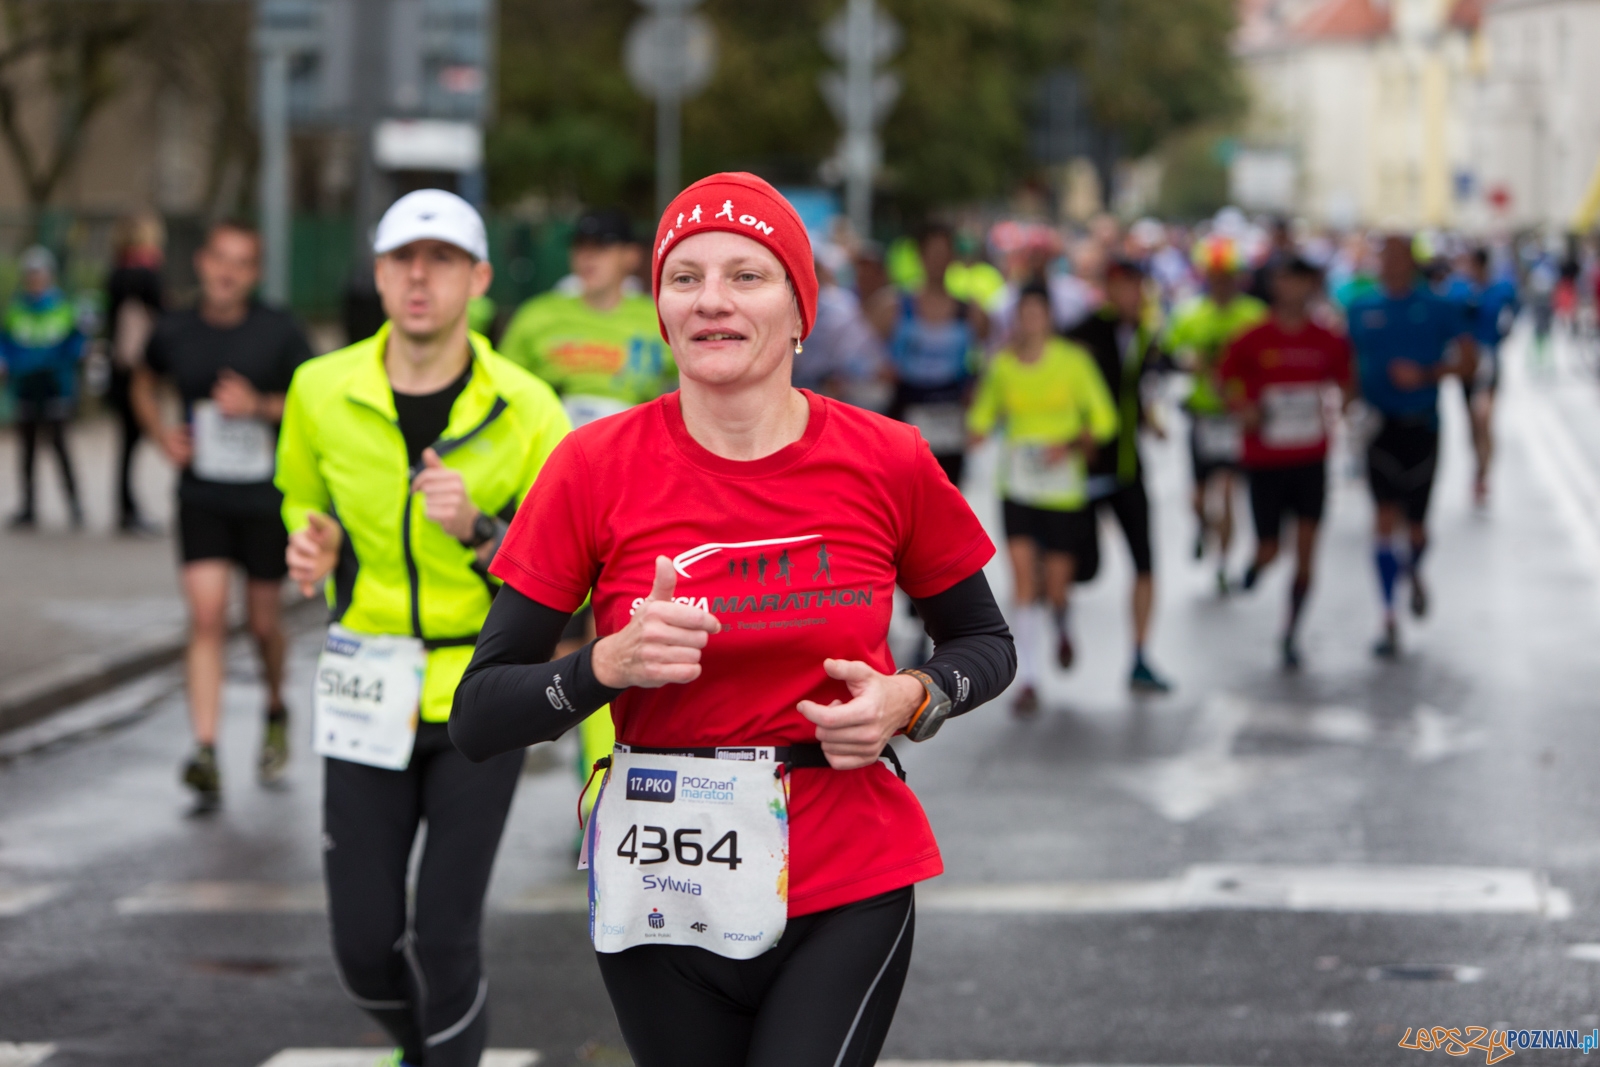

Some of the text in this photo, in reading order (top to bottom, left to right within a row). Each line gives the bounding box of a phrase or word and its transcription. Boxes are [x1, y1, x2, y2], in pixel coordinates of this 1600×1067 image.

[738, 214, 774, 236] ON
[681, 788, 734, 801] maraton
[617, 824, 742, 870] 4364
[642, 874, 703, 897] Sylwia
[690, 921, 709, 934] 4F
